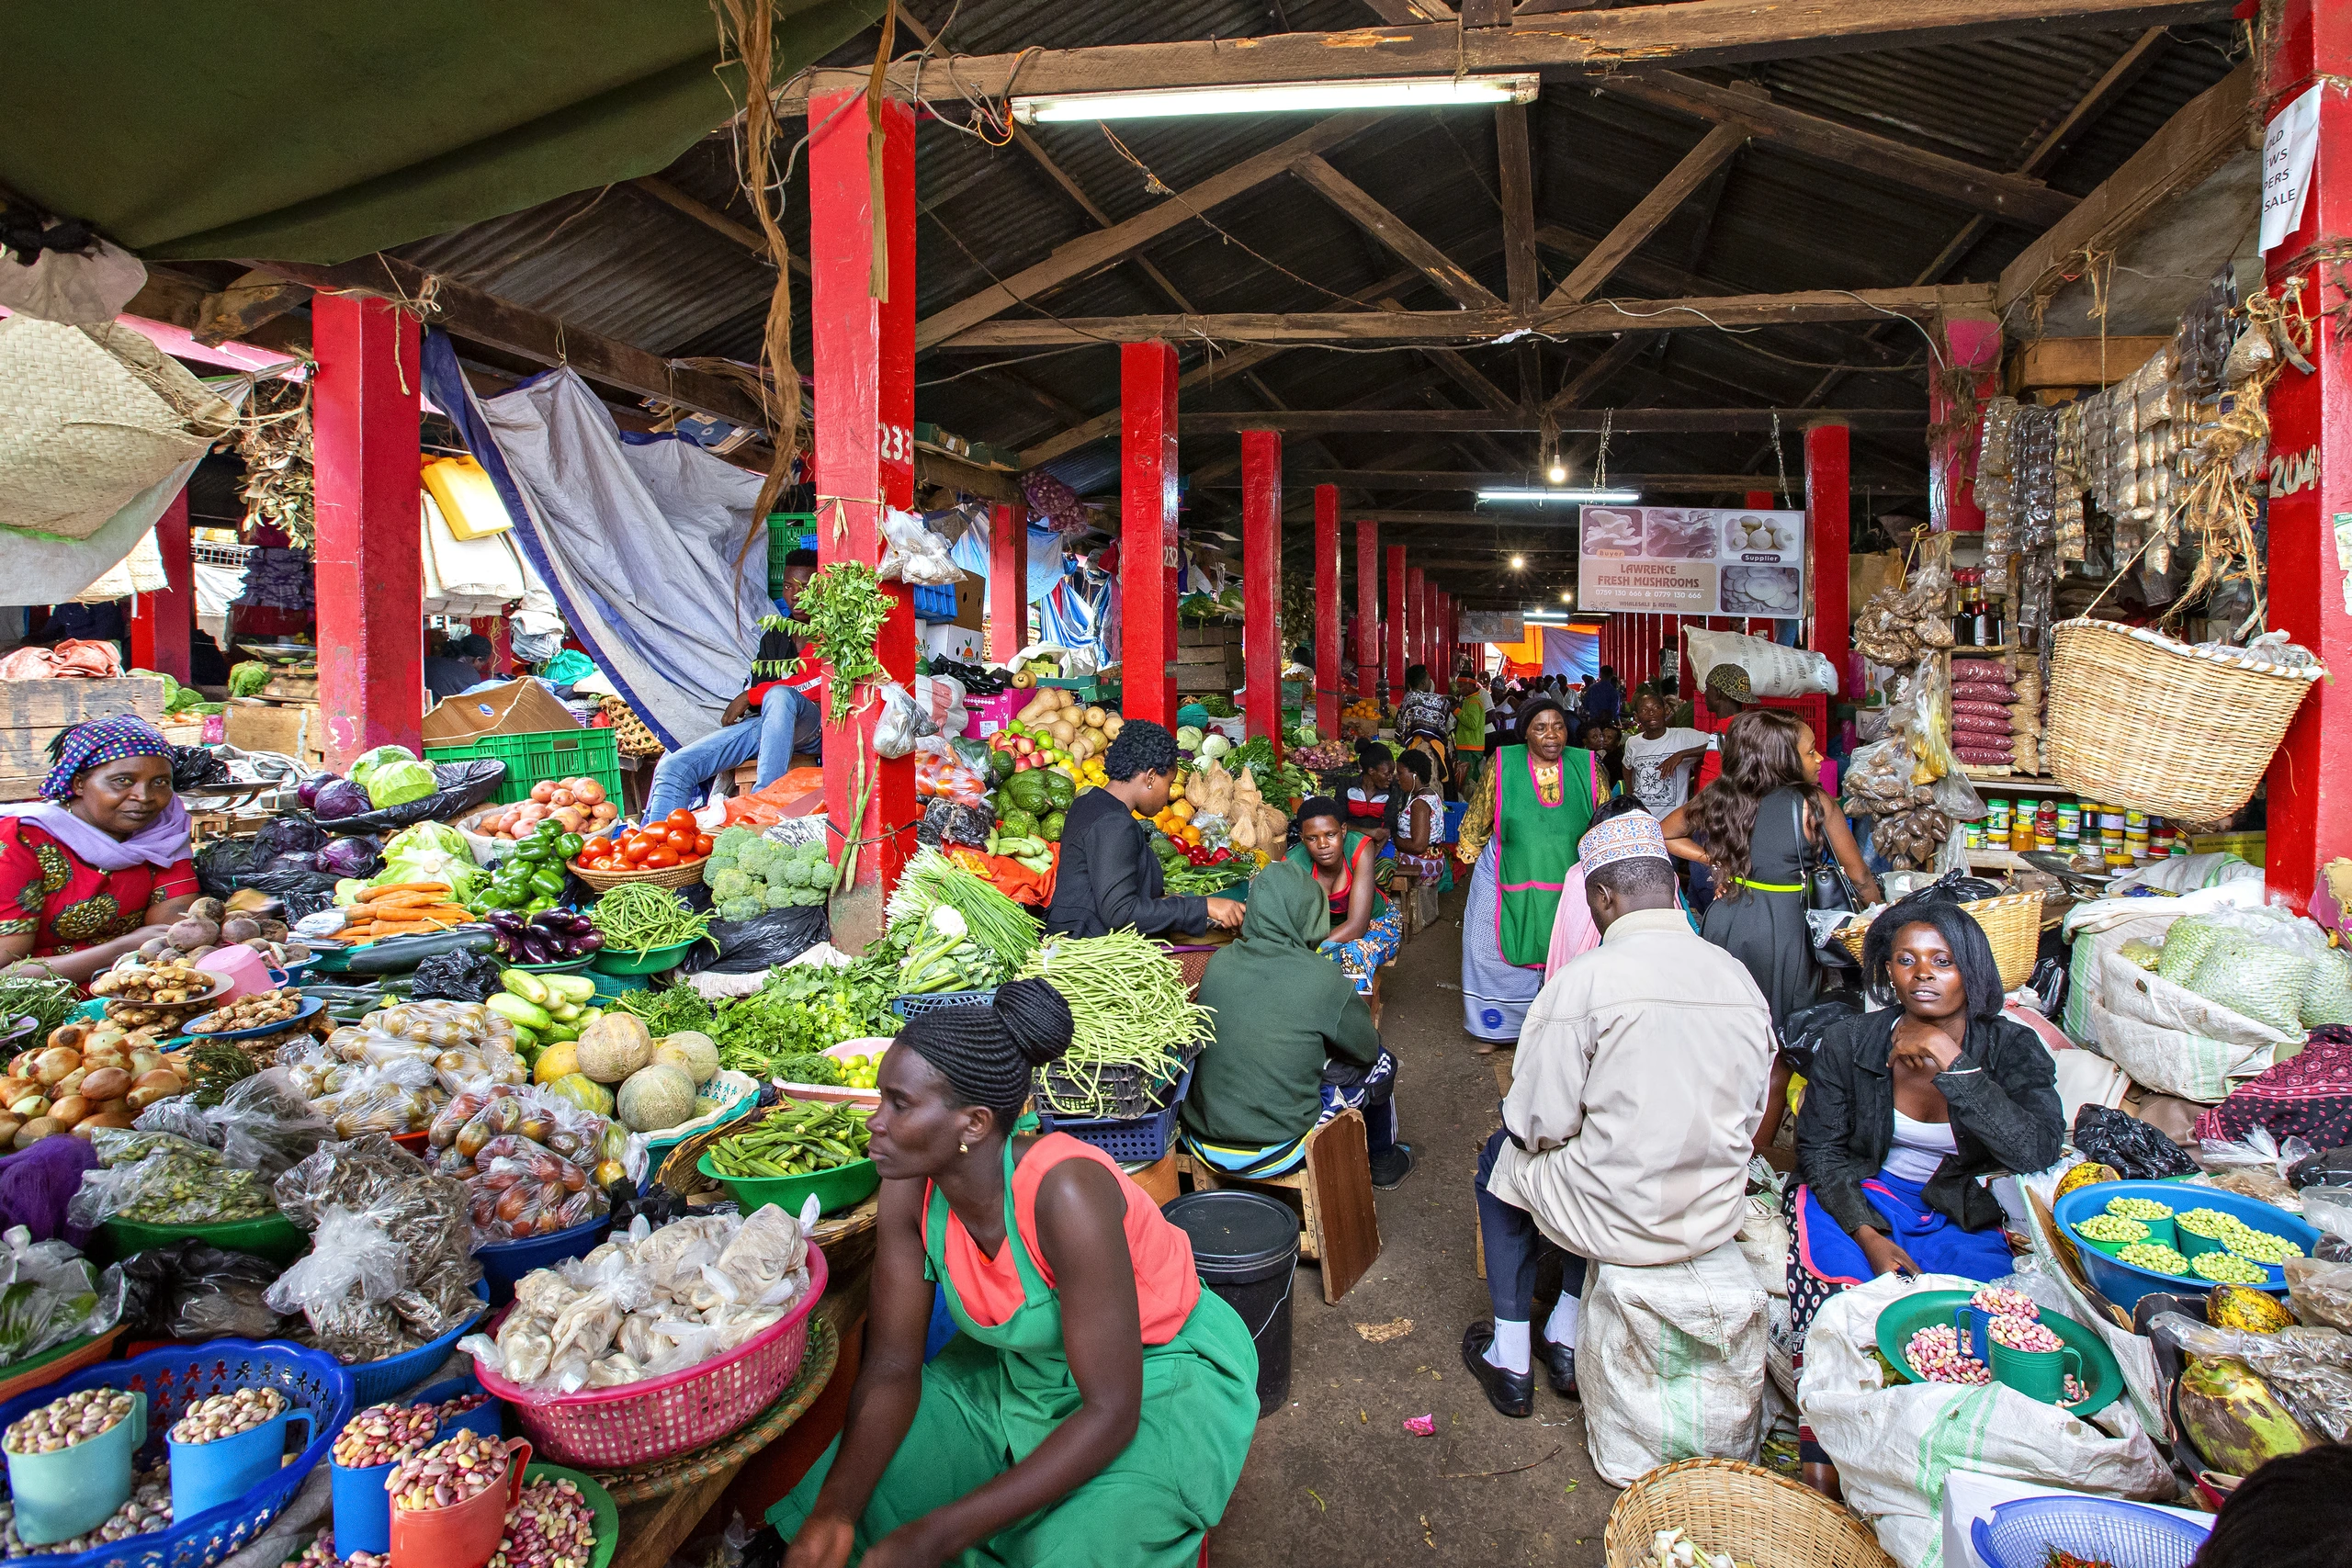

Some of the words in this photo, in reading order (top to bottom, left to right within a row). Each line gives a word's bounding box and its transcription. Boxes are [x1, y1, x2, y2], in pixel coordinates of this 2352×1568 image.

[2264, 188, 2296, 213] SALE
[1600, 550, 1623, 558] Buyer
[1745, 554, 1779, 563] Supplier
[1620, 564, 1677, 575] LAWRENCE
[1598, 575, 1630, 586] FRESH
[1634, 576, 1700, 588] MUSHROOMS
